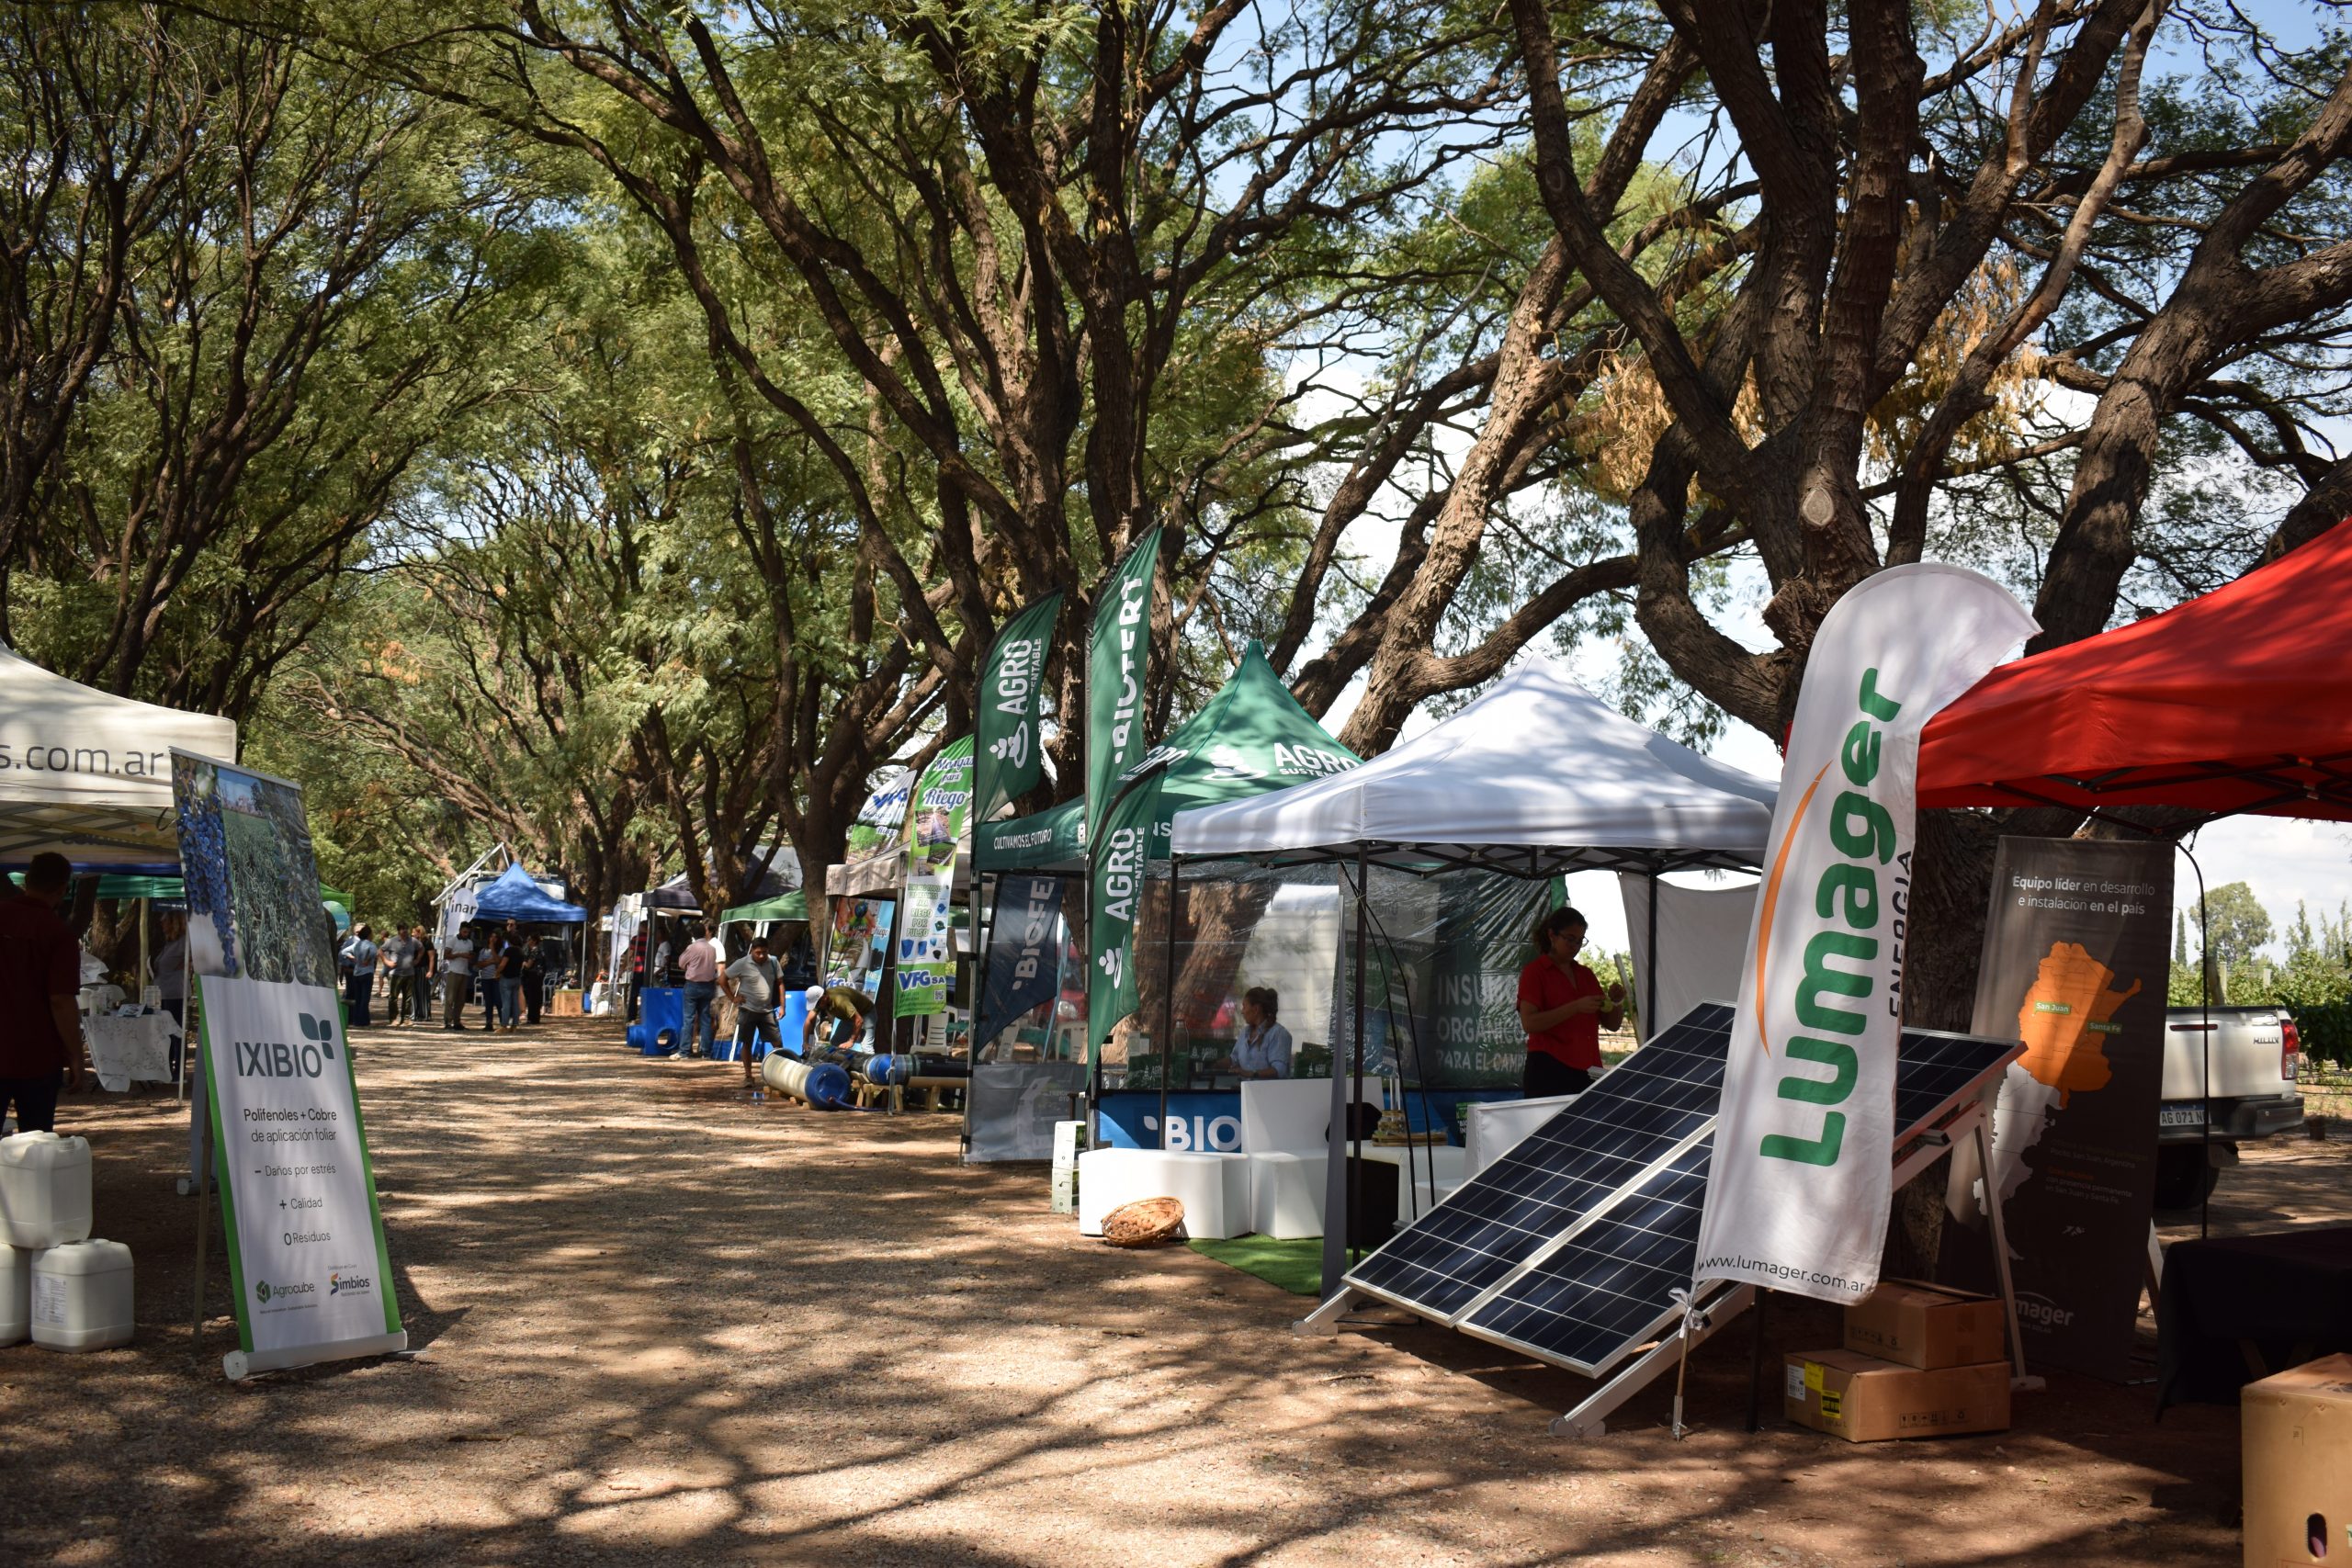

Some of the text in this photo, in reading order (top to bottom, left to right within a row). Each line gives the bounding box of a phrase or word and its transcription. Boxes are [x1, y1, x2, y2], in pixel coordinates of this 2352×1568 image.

[998, 639, 1033, 716] AGRO
[1274, 742, 1360, 773] AGRO
[925, 788, 966, 810] Riego
[994, 829, 1053, 850] CULTIVAMOS EL FUTURO
[1105, 828, 1135, 921] AGRO
[2054, 877, 2081, 891] líder
[2083, 881, 2098, 892] en
[2100, 881, 2155, 896] desarrollo
[451, 900, 477, 914] inar
[911, 908, 933, 918] RIEGO
[2018, 896, 2025, 906] e
[2089, 901, 2105, 912] en
[2108, 900, 2119, 913] el
[1760, 668, 1902, 1168] Lumager
[898, 971, 931, 990] VFG
[2090, 1022, 2122, 1032] Santa Fe
[235, 1043, 322, 1078] IXIBIO
[1435, 1049, 1471, 1070] PARA
[1476, 1052, 1488, 1071] EL
[243, 1108, 299, 1122] Polifenoles
[308, 1108, 337, 1121] Cobre
[2162, 1112, 2173, 1123] AG
[2176, 1111, 2194, 1123] 071
[251, 1129, 336, 1144] de aplicación foliar
[1165, 1115, 1241, 1152] BIO
[265, 1165, 293, 1177] Daños
[295, 1167, 309, 1178] por
[311, 1164, 336, 1175] estrés
[290, 1198, 323, 1209] Calidad
[293, 1231, 332, 1243] Residuos
[273, 1280, 315, 1298] Agrocube
